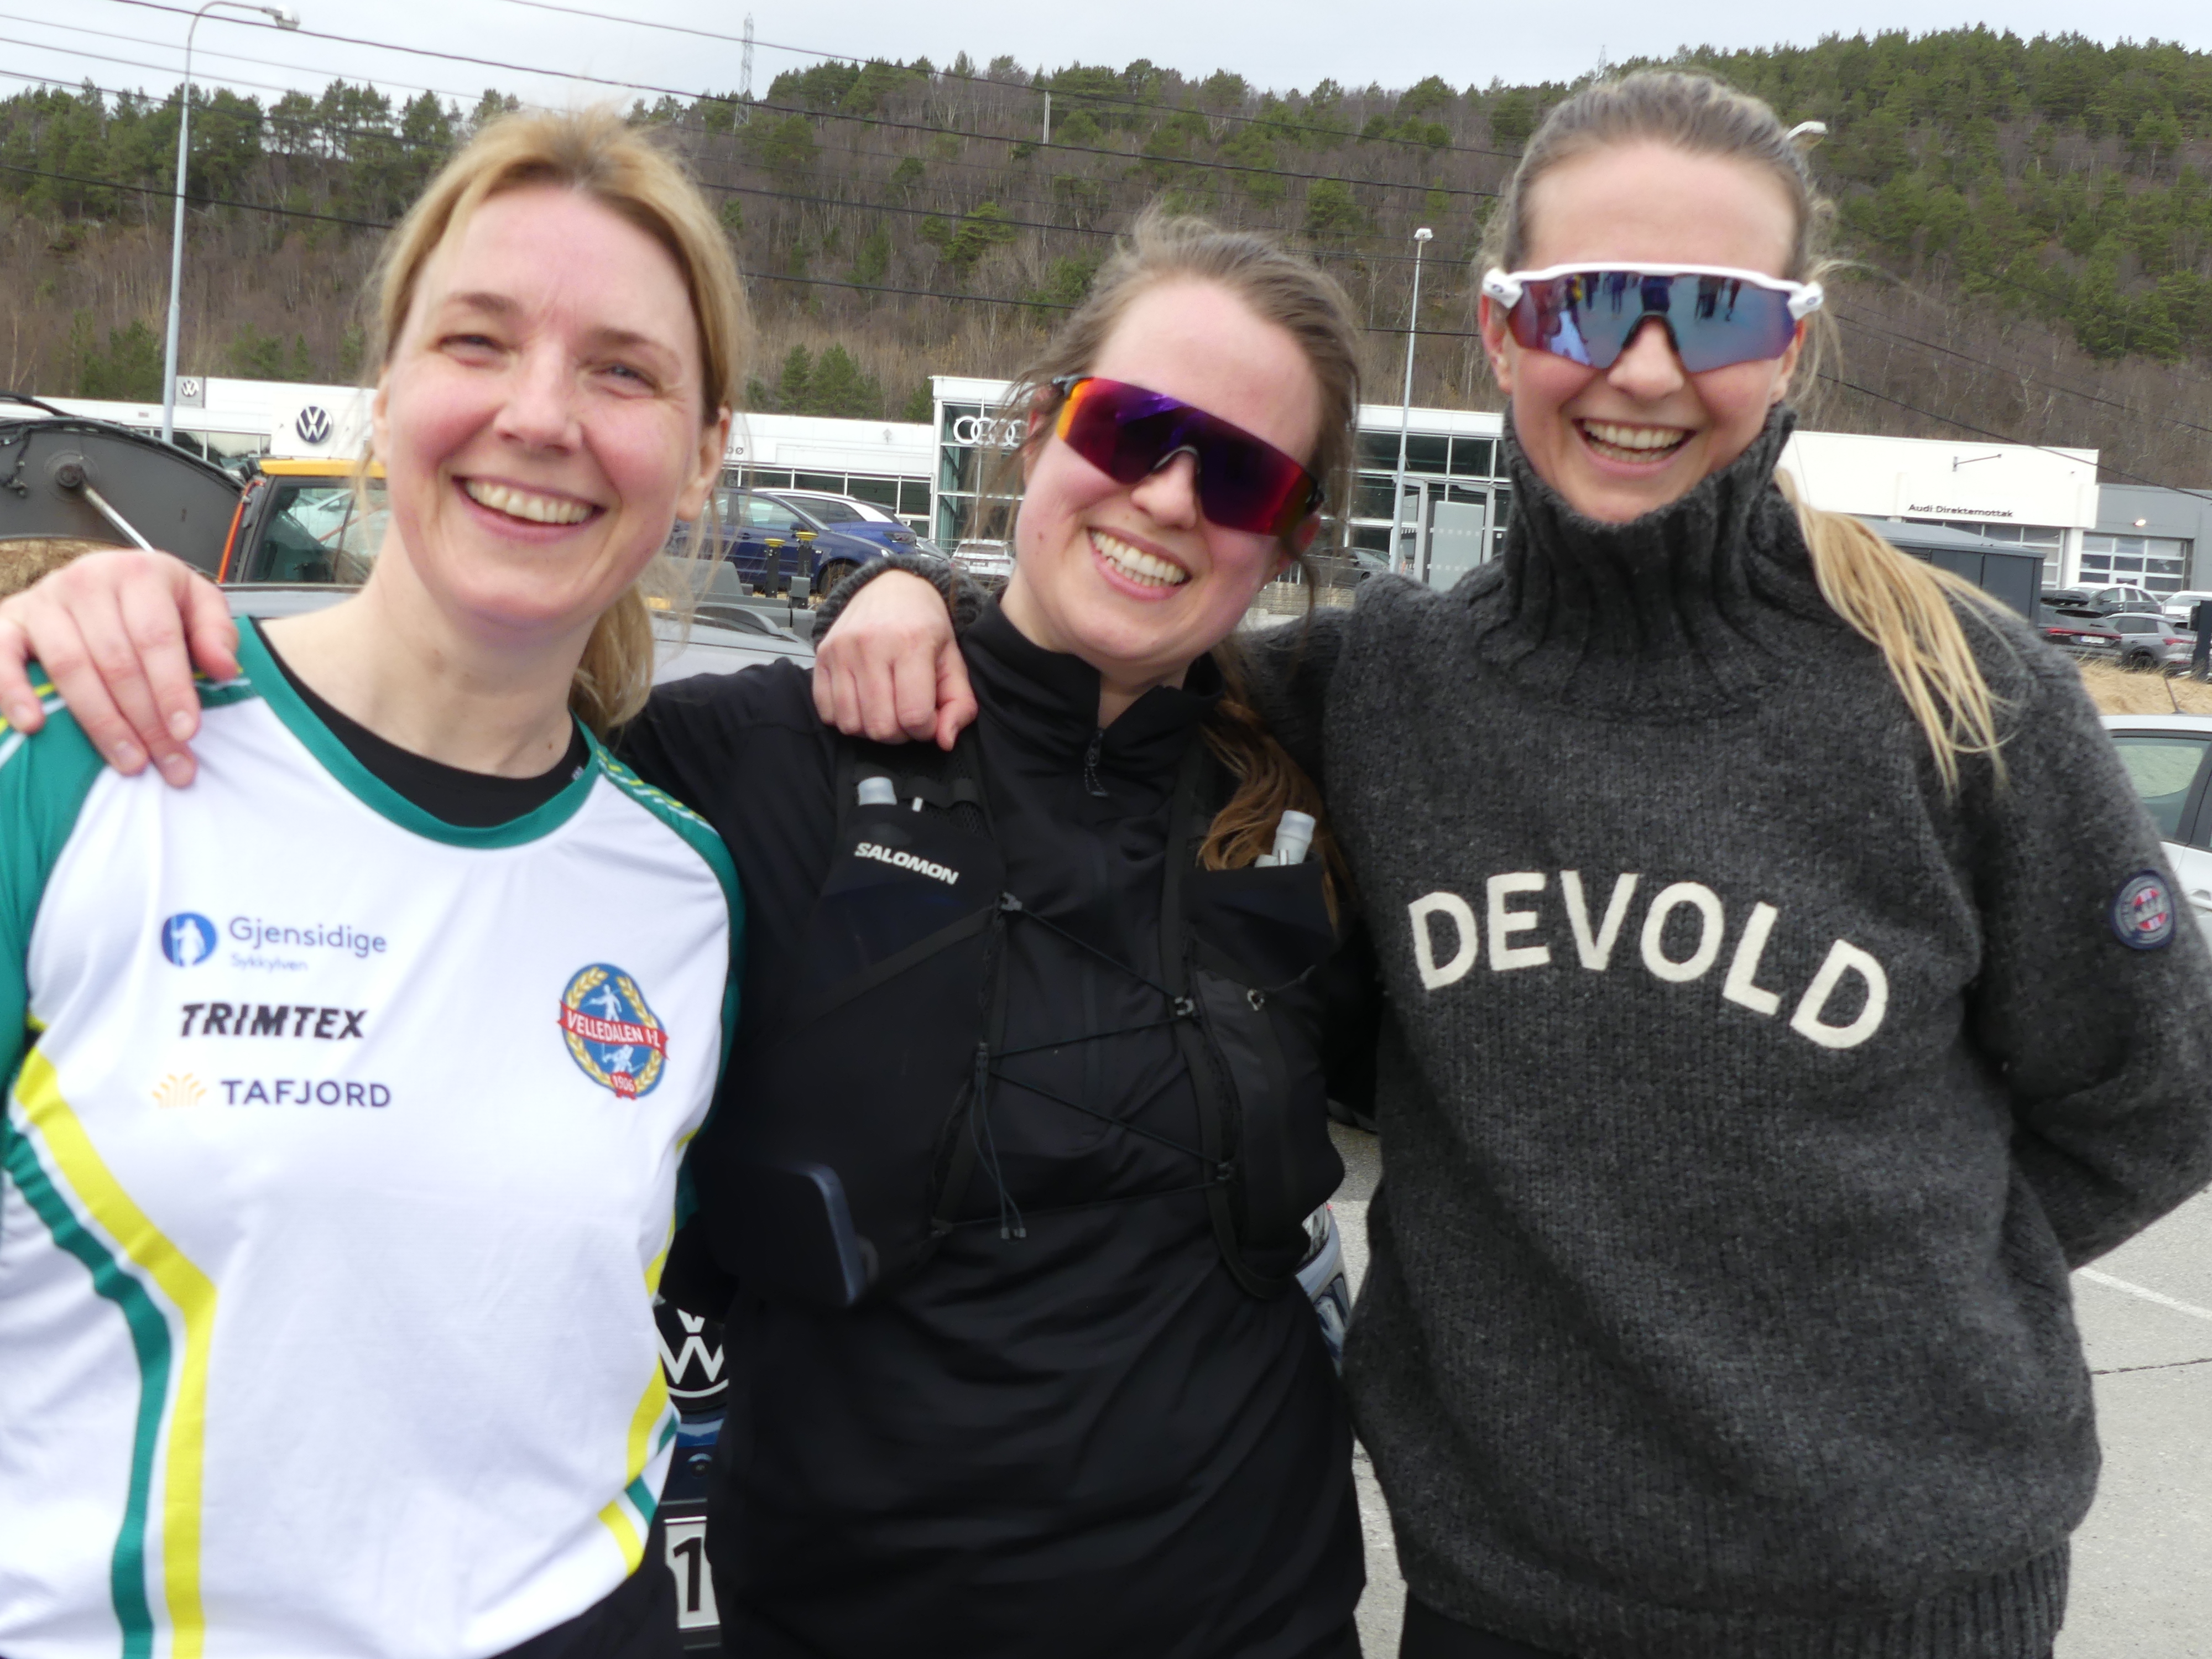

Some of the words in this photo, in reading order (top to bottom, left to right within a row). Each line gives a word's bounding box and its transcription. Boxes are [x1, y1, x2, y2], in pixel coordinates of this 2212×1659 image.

[296, 405, 332, 444] VW
[1907, 504, 1933, 513] Audi
[1936, 505, 2013, 518] Direktemottak
[854, 842, 959, 885] SALOMON
[228, 916, 387, 958] Gjensidige
[1407, 870, 1888, 1049] DEVOLD
[180, 1002, 368, 1040] TRIMTEX
[566, 1009, 644, 1043] VELLEDALEN
[221, 1079, 392, 1108] TAFJORD
